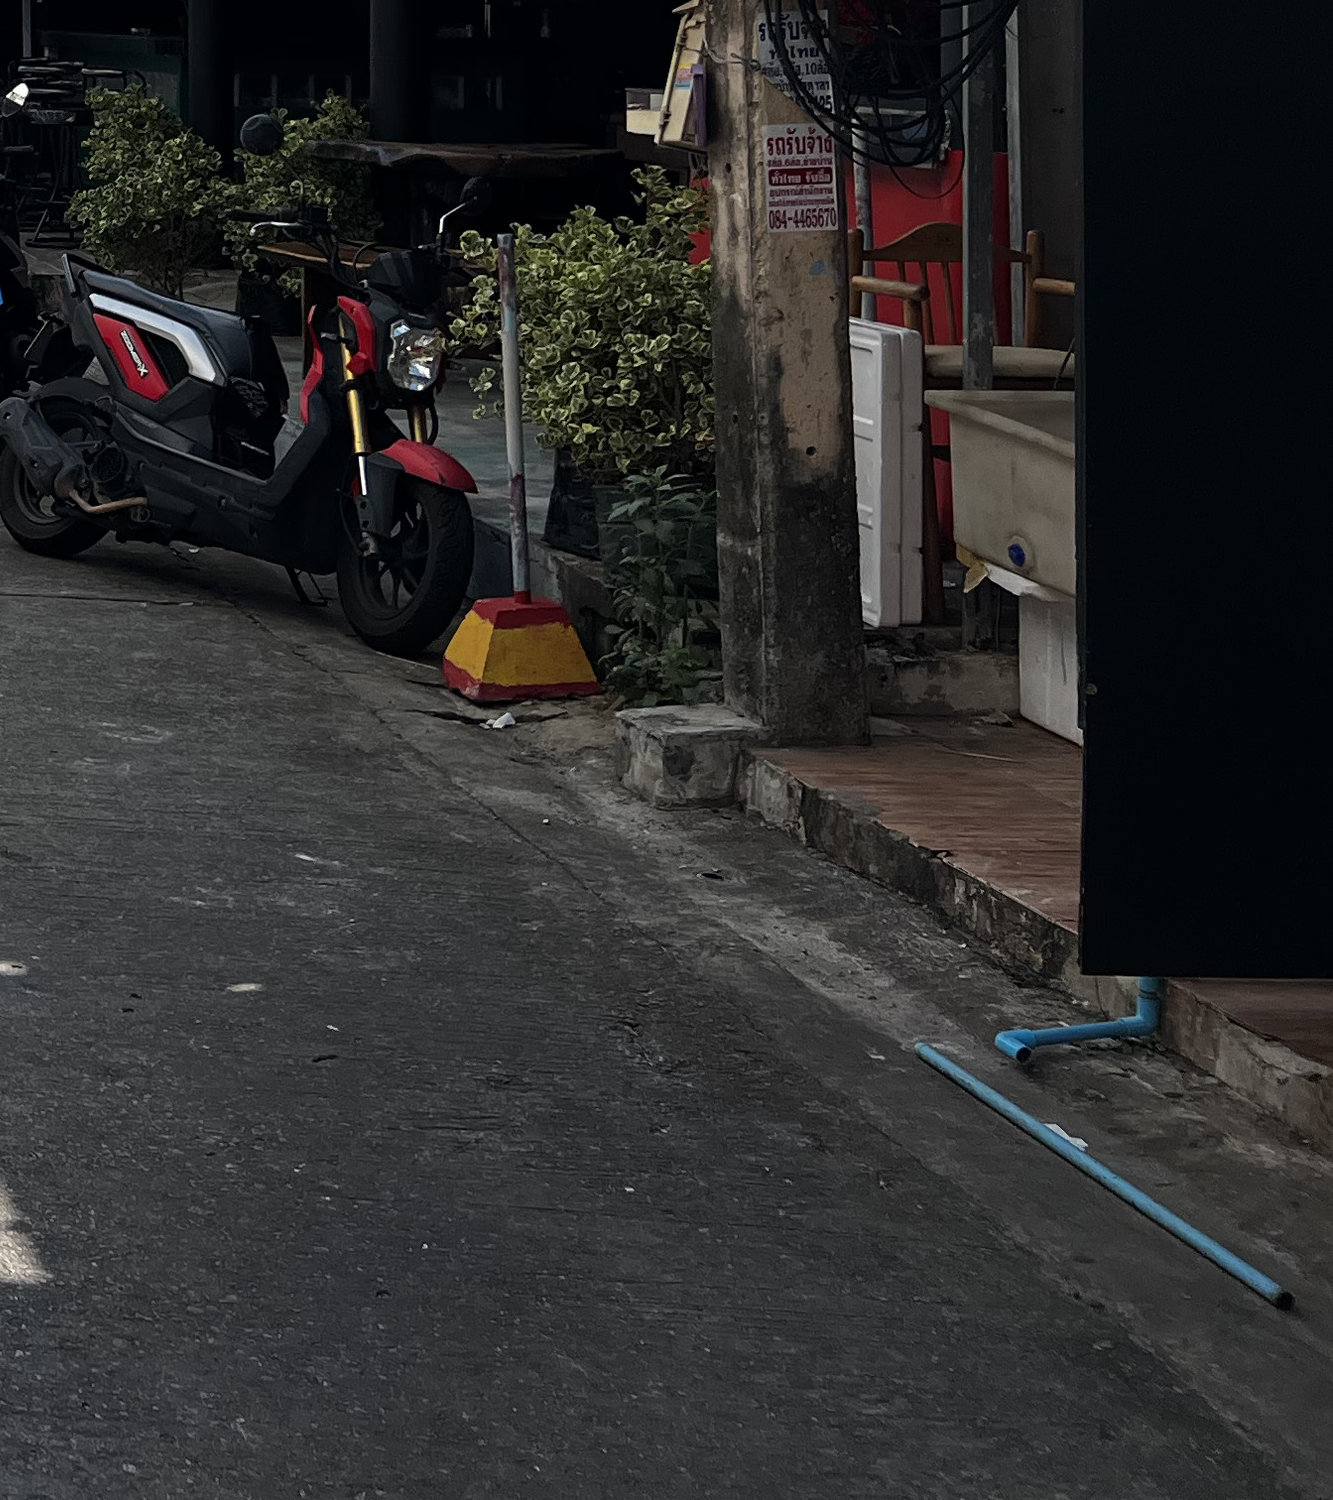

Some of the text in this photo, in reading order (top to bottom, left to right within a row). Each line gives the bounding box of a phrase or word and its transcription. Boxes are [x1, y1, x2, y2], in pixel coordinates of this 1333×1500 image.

[767, 127, 832, 156] รถรับจ้าง
[769, 207, 837, 229] 084-4465670
